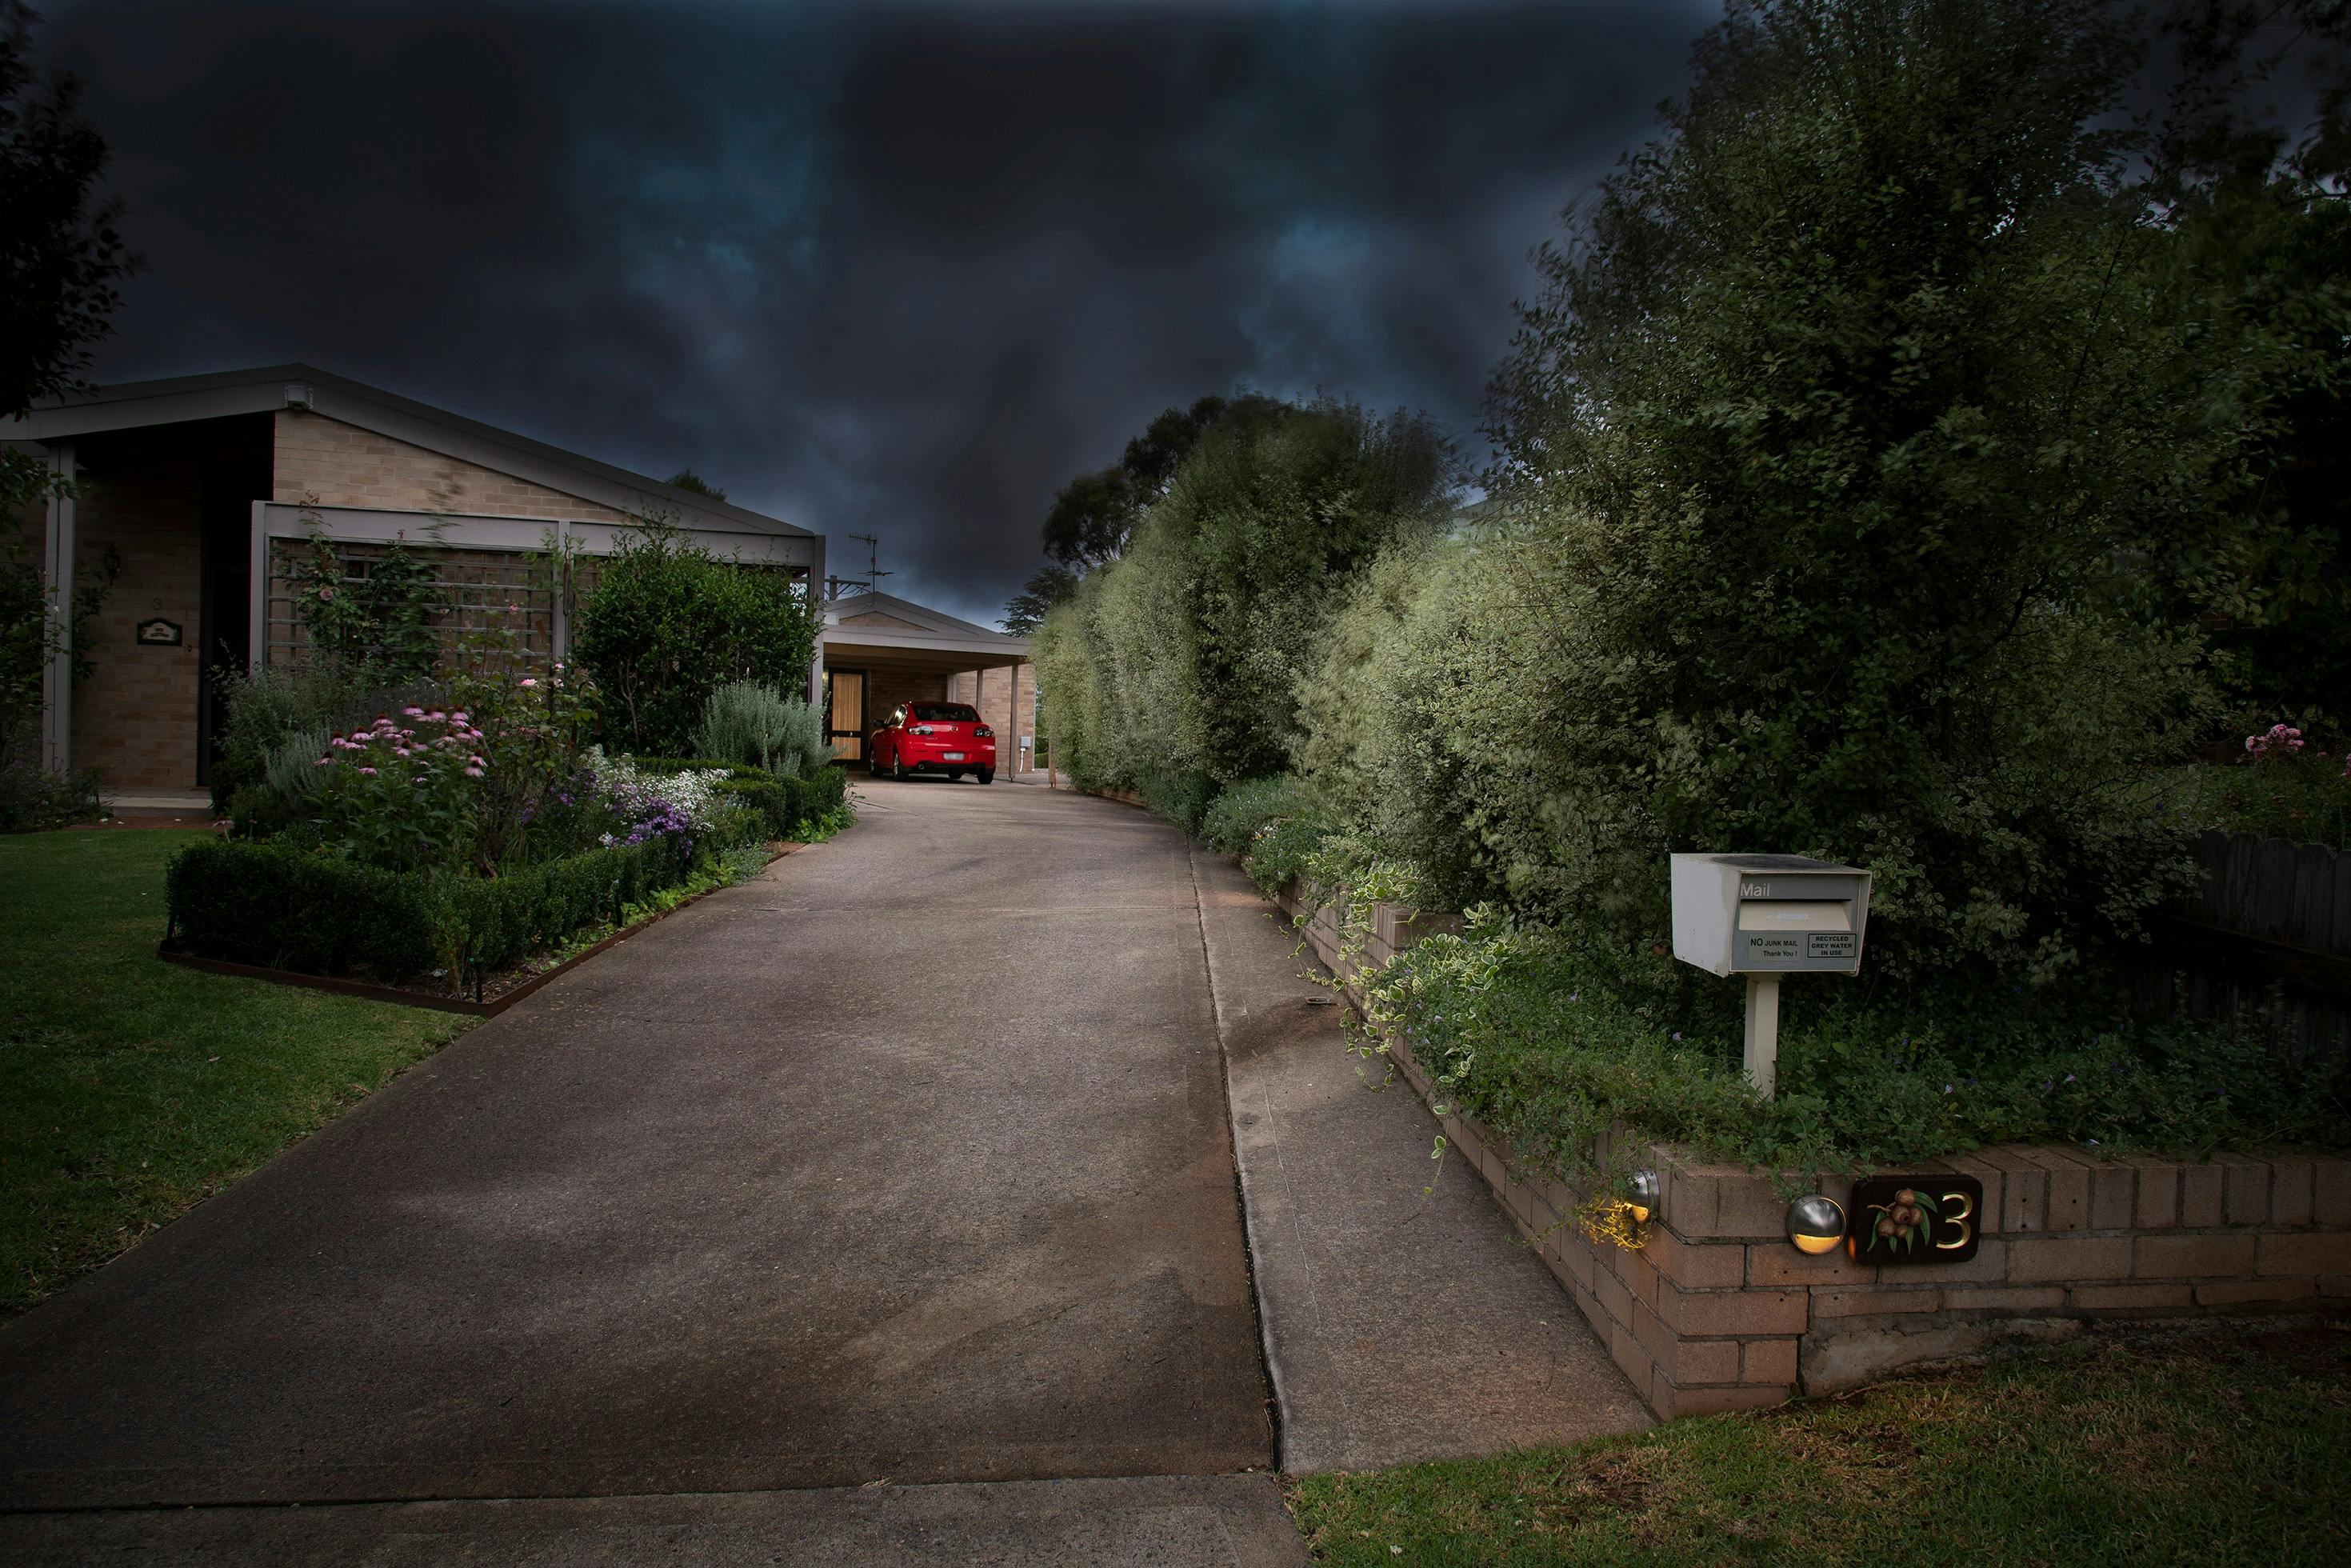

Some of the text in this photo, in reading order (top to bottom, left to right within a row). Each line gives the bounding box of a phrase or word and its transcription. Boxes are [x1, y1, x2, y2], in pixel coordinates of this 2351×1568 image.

[1740, 883, 1770, 897] Mail
[1750, 938, 1763, 946] NO
[1936, 1190, 1973, 1250] 3
